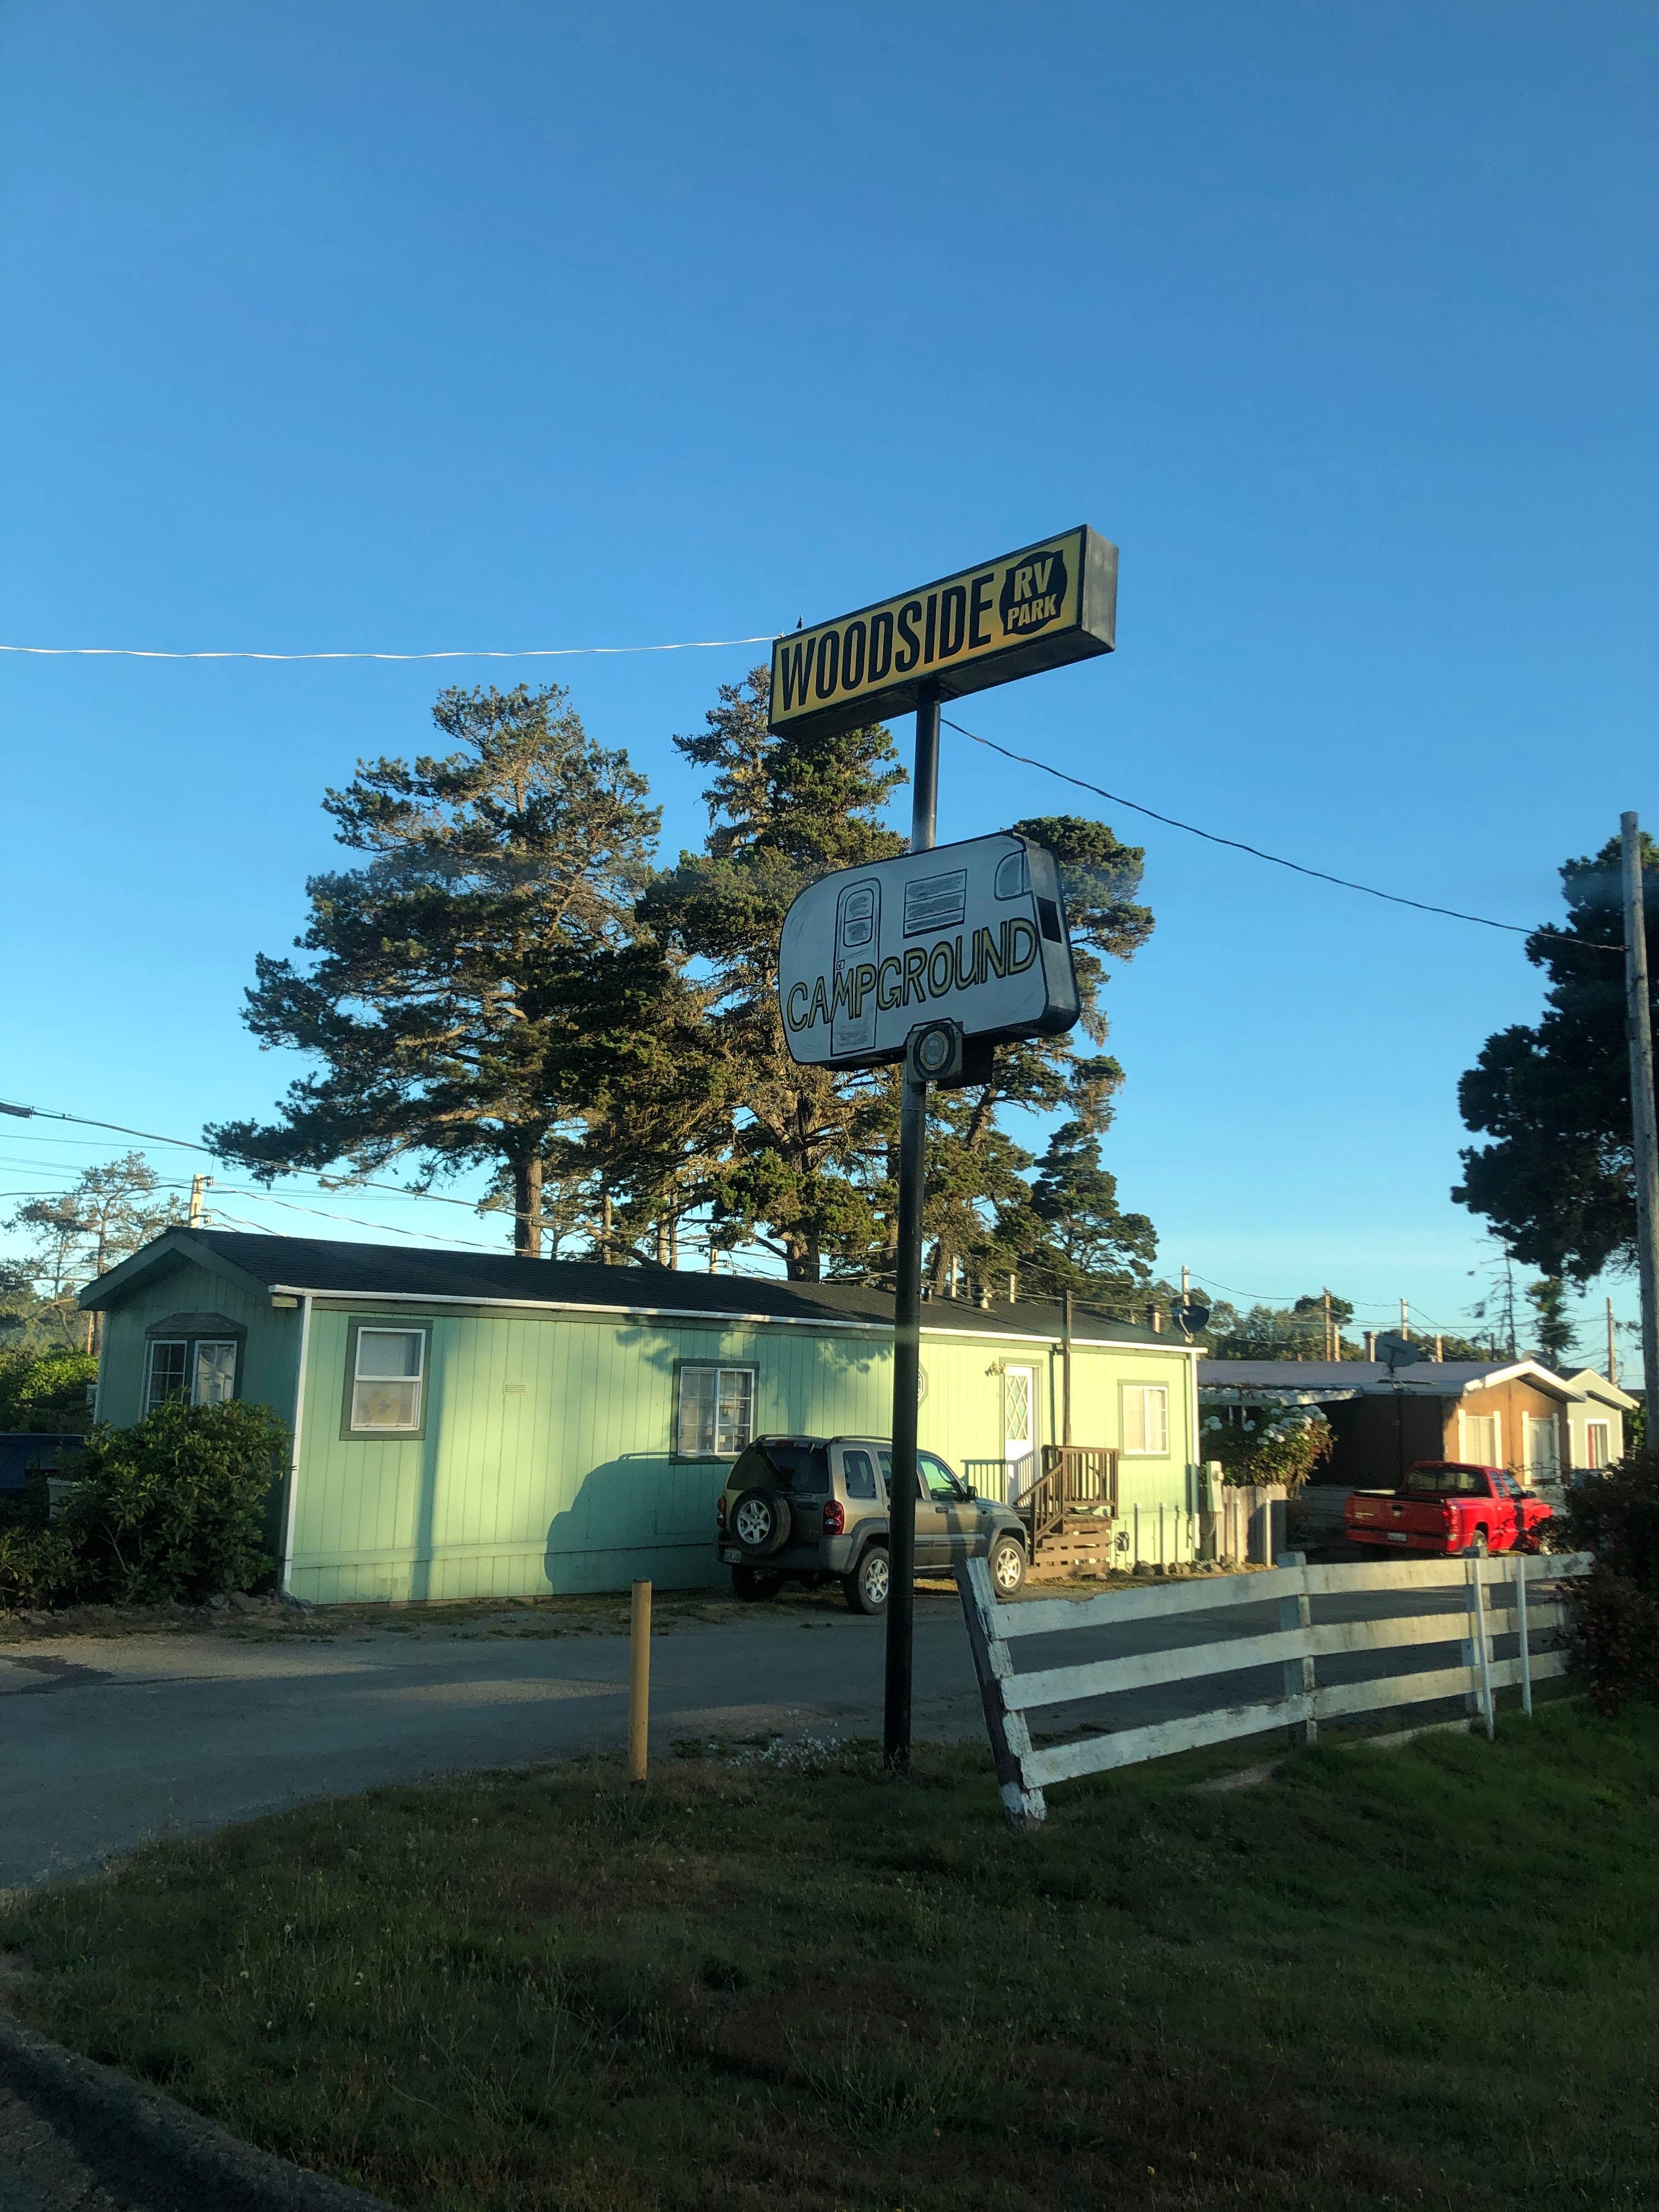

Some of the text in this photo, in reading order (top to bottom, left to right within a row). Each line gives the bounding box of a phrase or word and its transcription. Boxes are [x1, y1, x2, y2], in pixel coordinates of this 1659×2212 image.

[1007, 593, 1058, 631] PARK
[1014, 557, 1054, 602] RV
[781, 572, 995, 712] WOODSIDE
[786, 917, 1038, 1032] CAMPGROUND
